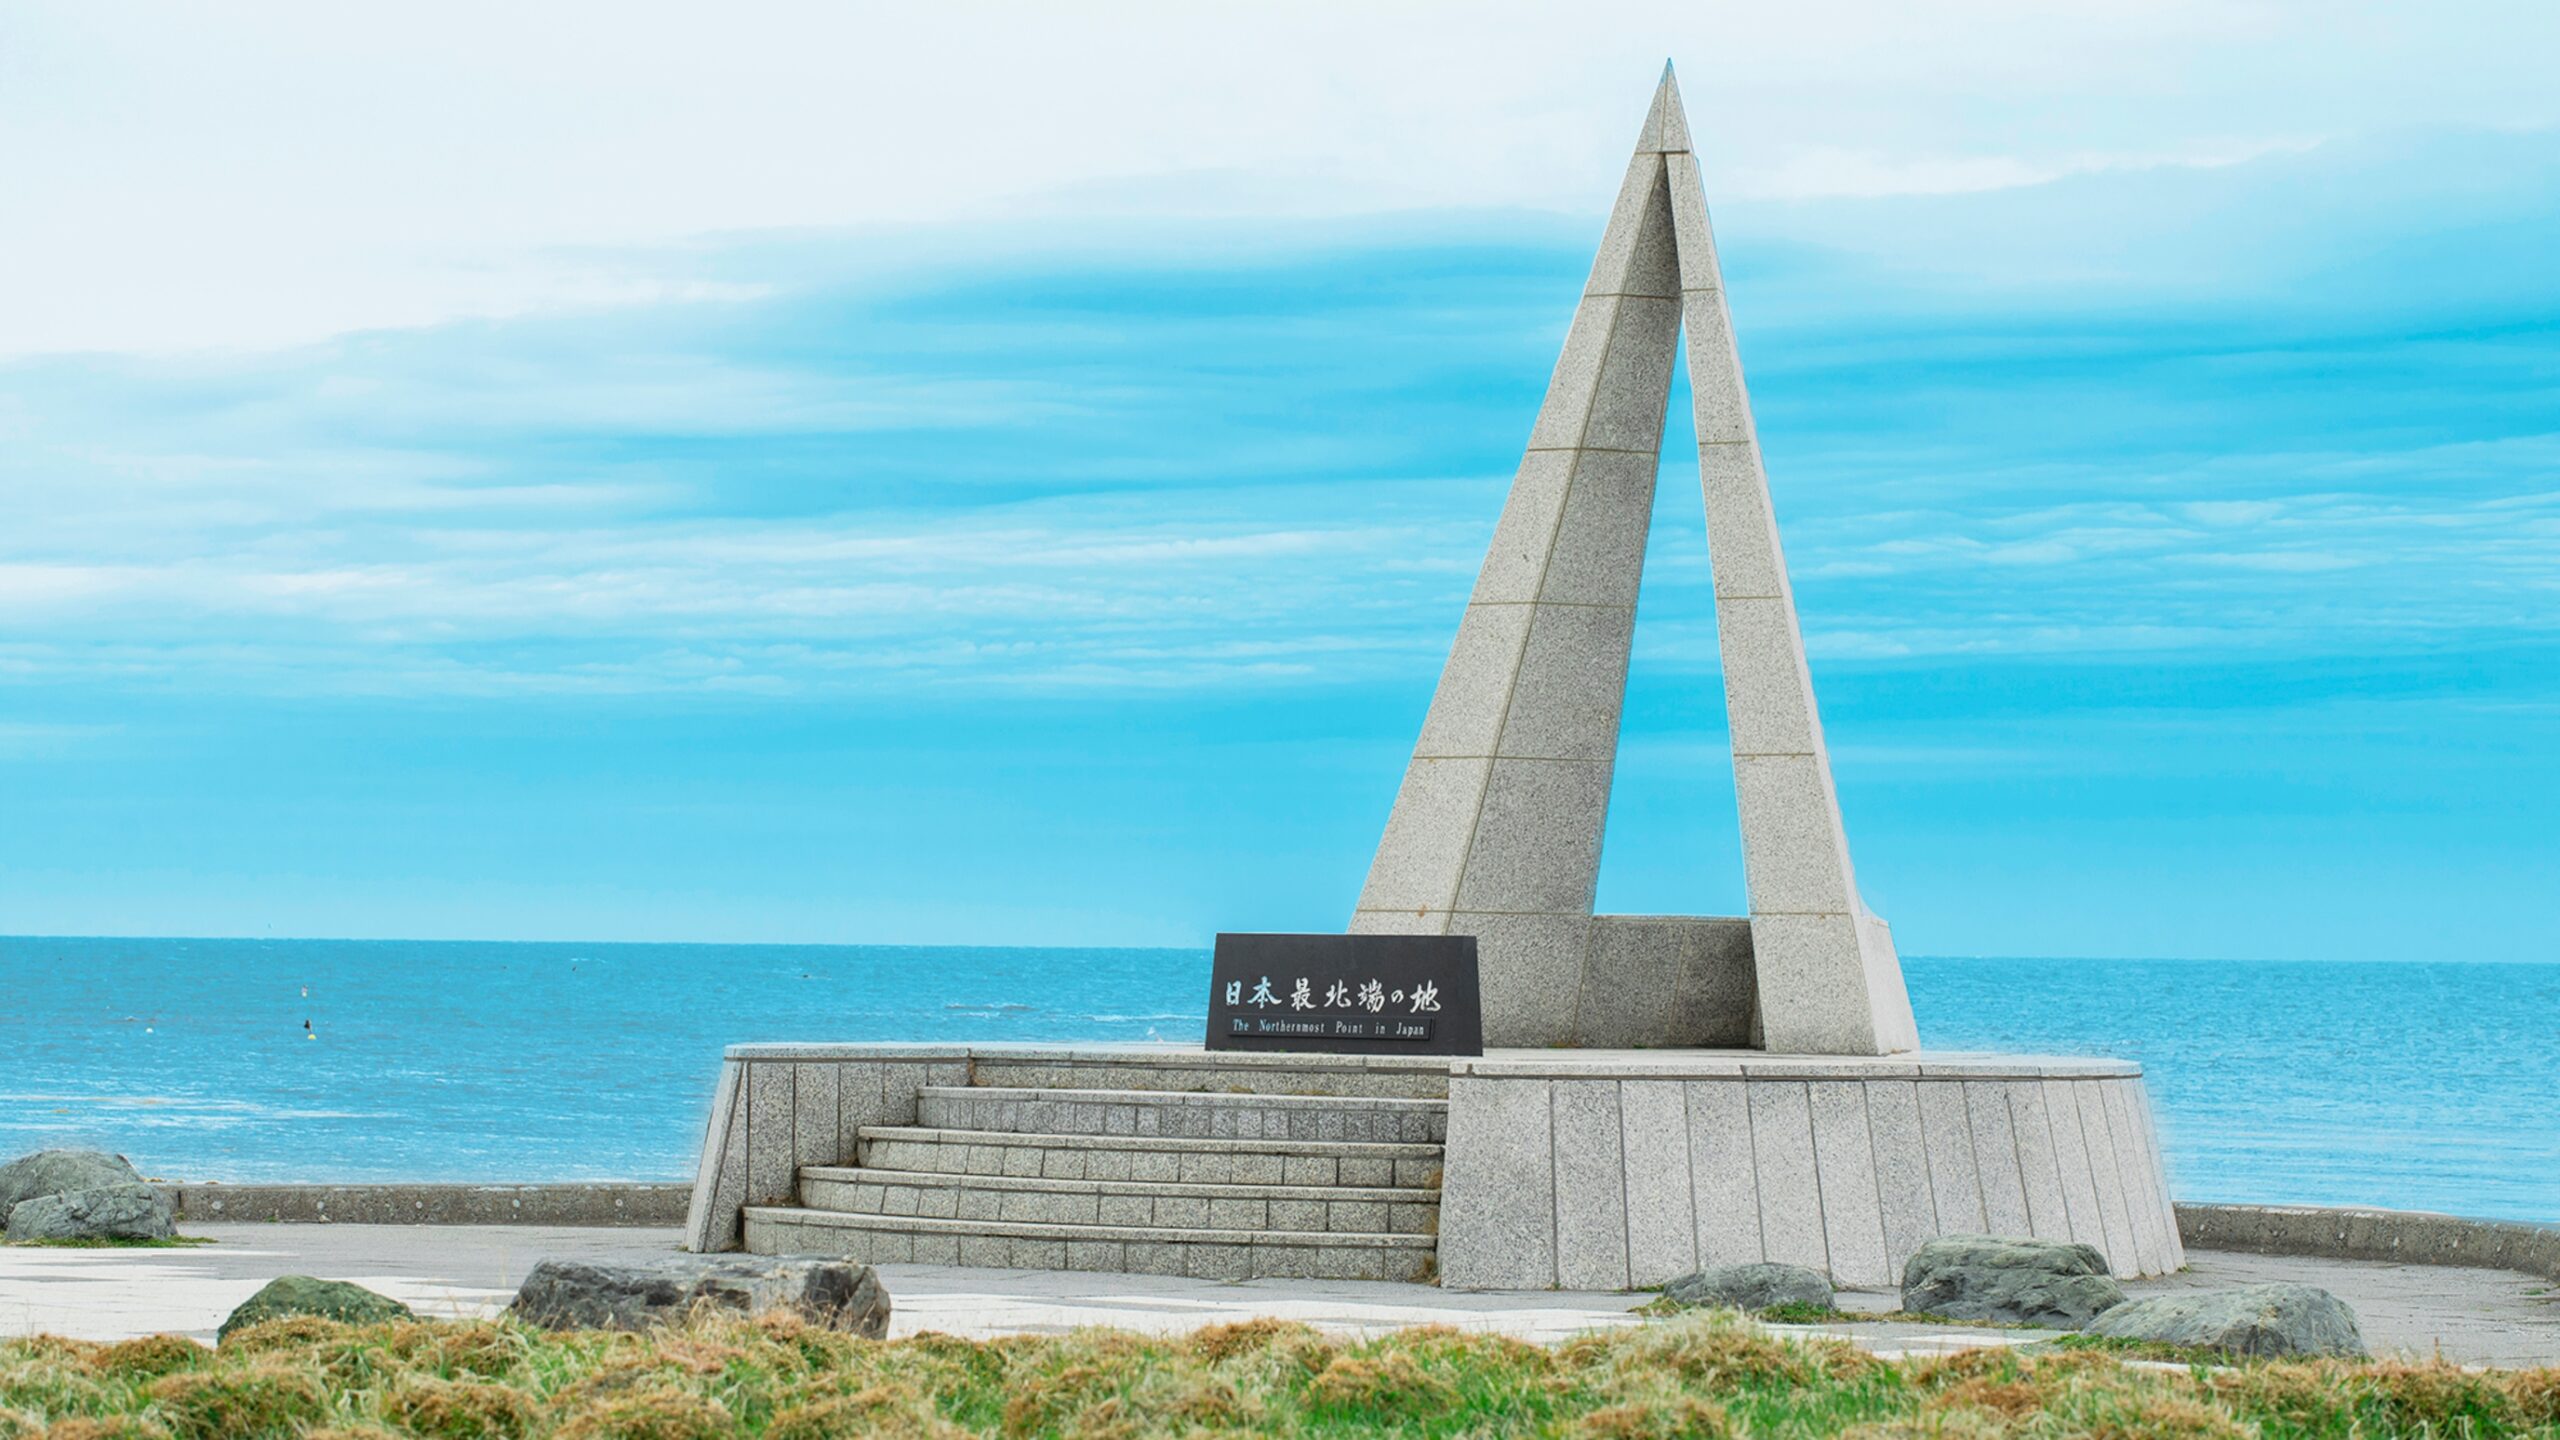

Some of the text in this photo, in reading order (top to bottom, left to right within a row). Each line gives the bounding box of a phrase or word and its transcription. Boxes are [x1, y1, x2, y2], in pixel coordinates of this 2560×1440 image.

[1225, 976, 1441, 1013] 日本最北端の地
[1232, 1018, 1425, 1038] The Northernmost Point in Japan
